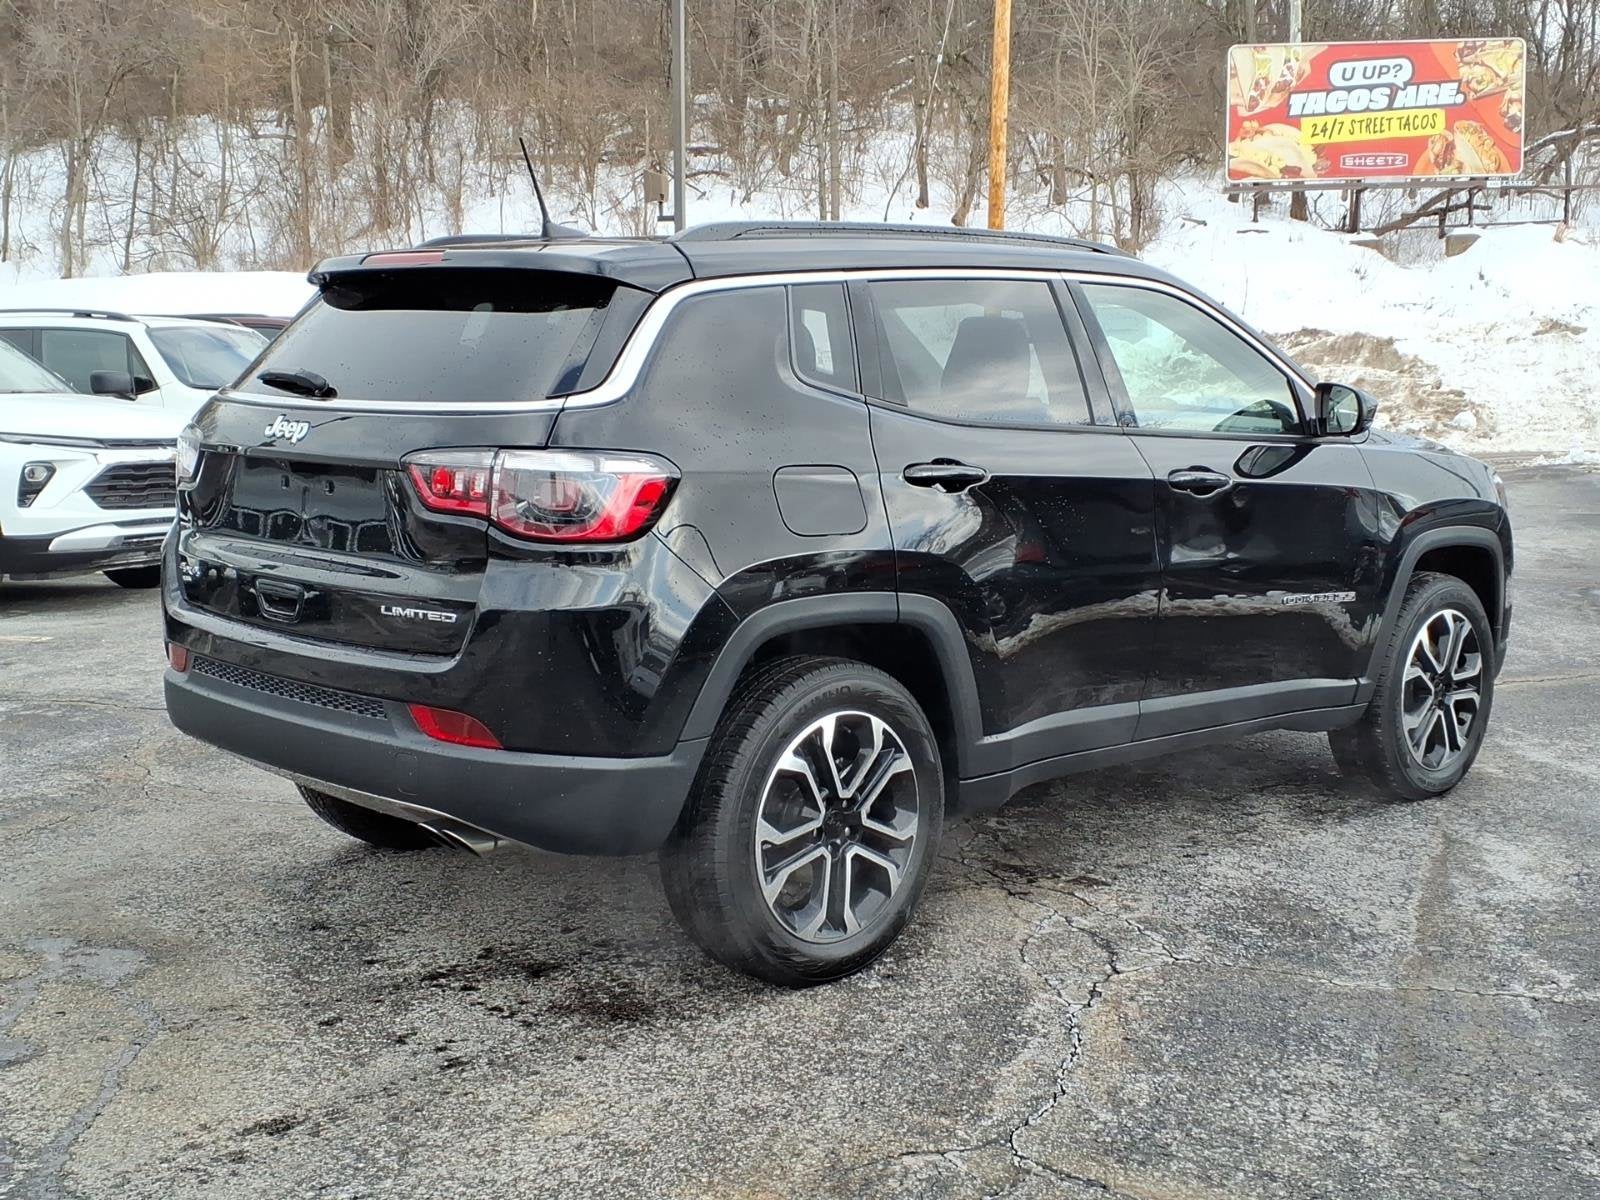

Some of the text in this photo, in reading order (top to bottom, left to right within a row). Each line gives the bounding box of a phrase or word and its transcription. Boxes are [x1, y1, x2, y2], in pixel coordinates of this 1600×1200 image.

[1341, 63, 1404, 82] U UP?
[1288, 81, 1466, 117] TACOS ARE.
[1310, 112, 1438, 140] 24/7 STREET TACOS
[1344, 155, 1404, 166] SHEETZ
[264, 414, 311, 444] Jeep
[380, 604, 457, 623] LIMITED
